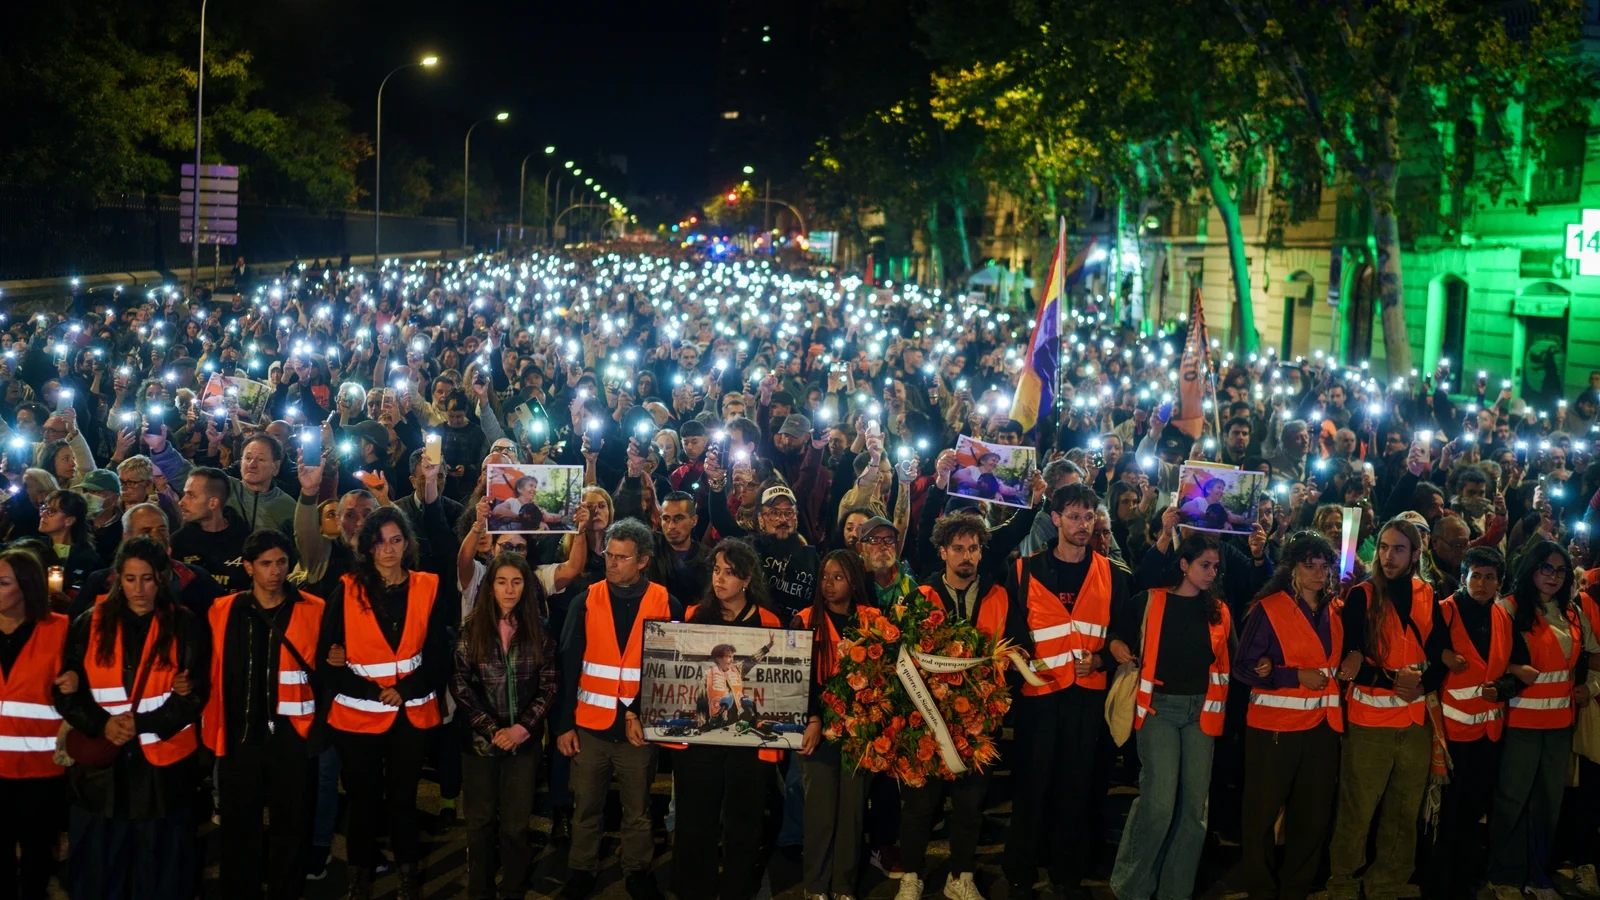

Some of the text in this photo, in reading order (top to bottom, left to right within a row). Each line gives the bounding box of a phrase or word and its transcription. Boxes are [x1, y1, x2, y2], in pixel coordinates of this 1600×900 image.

[643, 662, 703, 681] UNA VIDA
[756, 668, 803, 684] BARRIO
